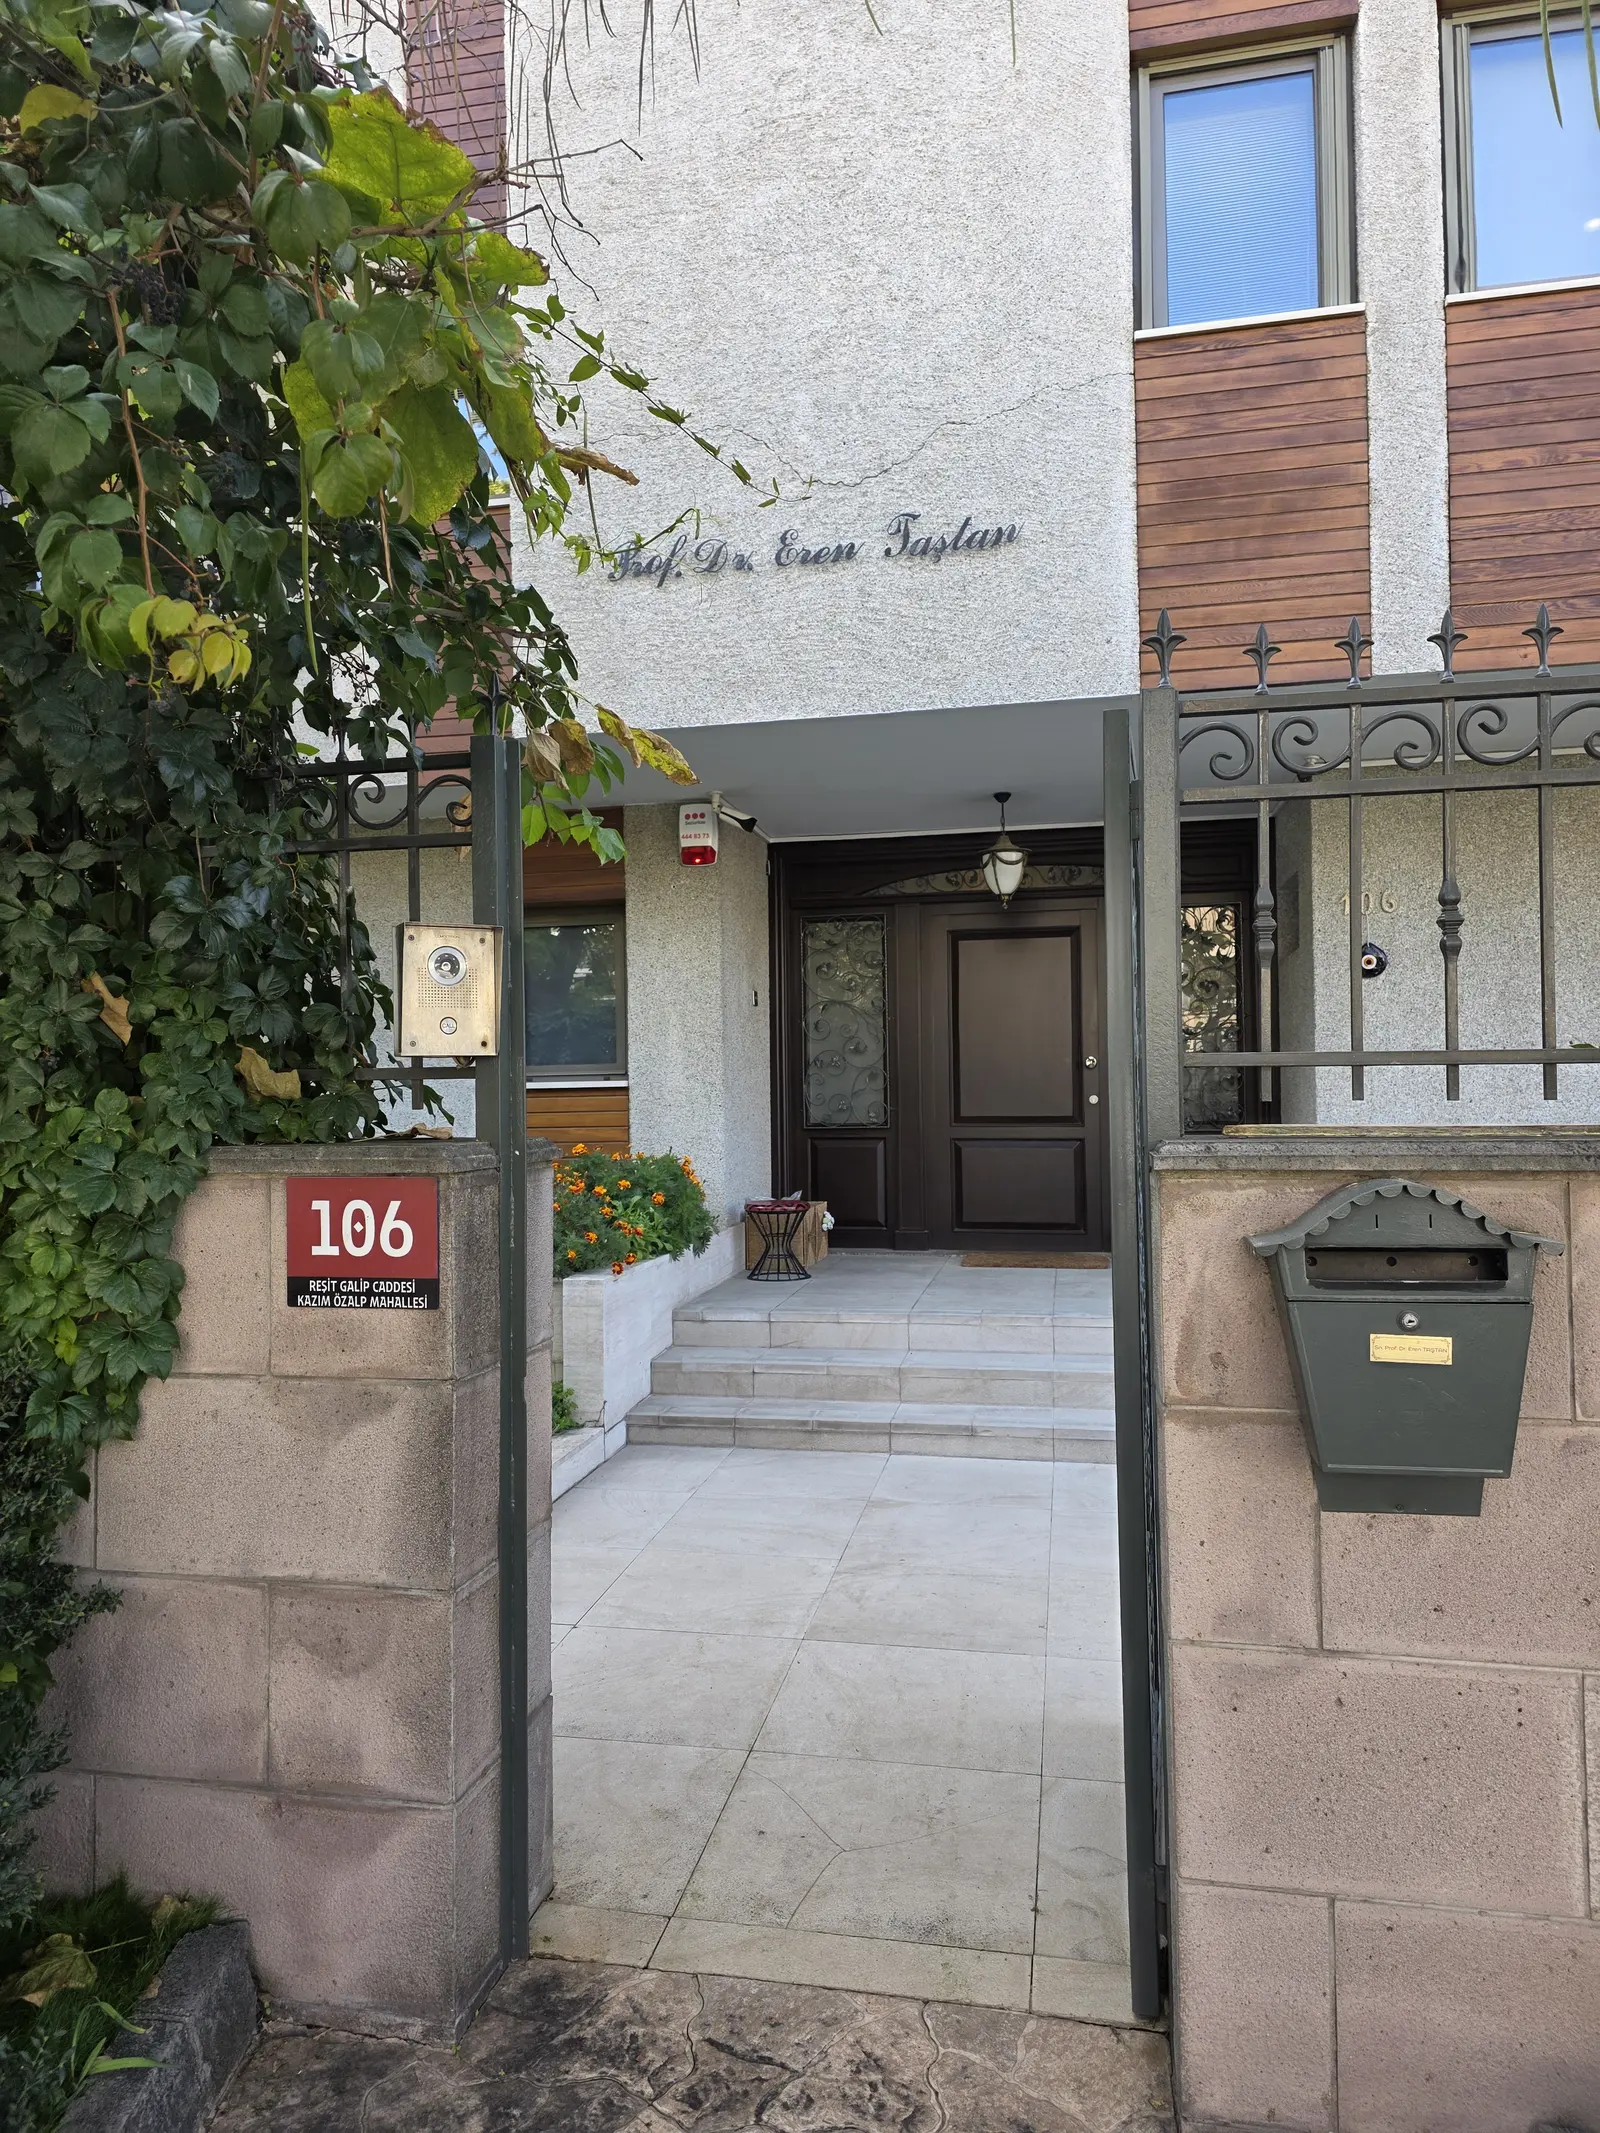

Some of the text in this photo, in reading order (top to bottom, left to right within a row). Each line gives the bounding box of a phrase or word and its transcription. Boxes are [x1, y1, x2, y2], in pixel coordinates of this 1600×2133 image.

[693, 538, 754, 573] Dr.
[775, 528, 865, 567] Eren
[884, 512, 1025, 563] Taştan
[311, 1199, 414, 1258] 106
[297, 1293, 428, 1309] KAZIM ÖZALP MAHALLESİ
[309, 1277, 416, 1293] REŞİT GALİP CADDESİ
